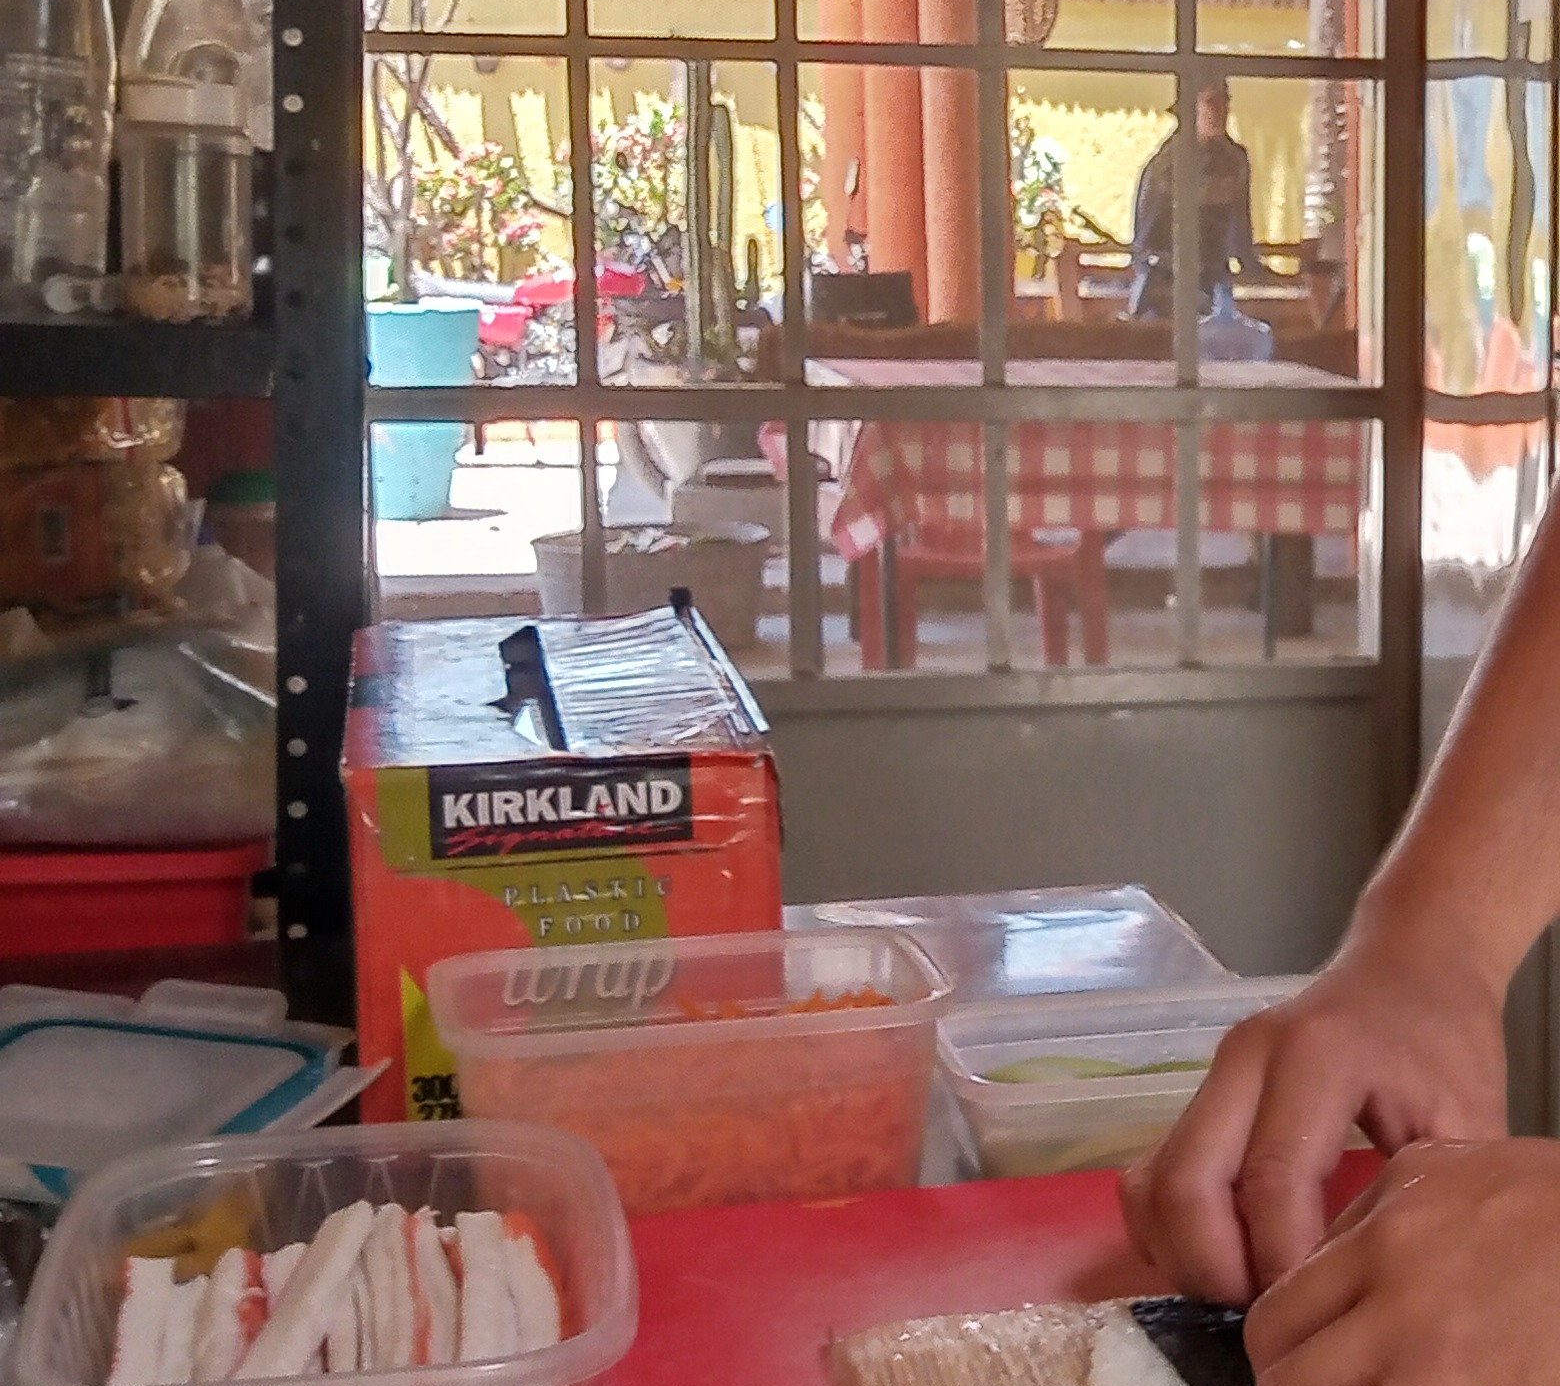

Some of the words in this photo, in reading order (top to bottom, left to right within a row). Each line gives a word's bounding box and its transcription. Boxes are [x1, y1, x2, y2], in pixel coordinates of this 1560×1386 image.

[443, 780, 683, 829] KIRKLAND
[504, 875, 672, 906] PLASTIC
[538, 909, 641, 938] FOOD
[502, 951, 677, 1010] wrap
